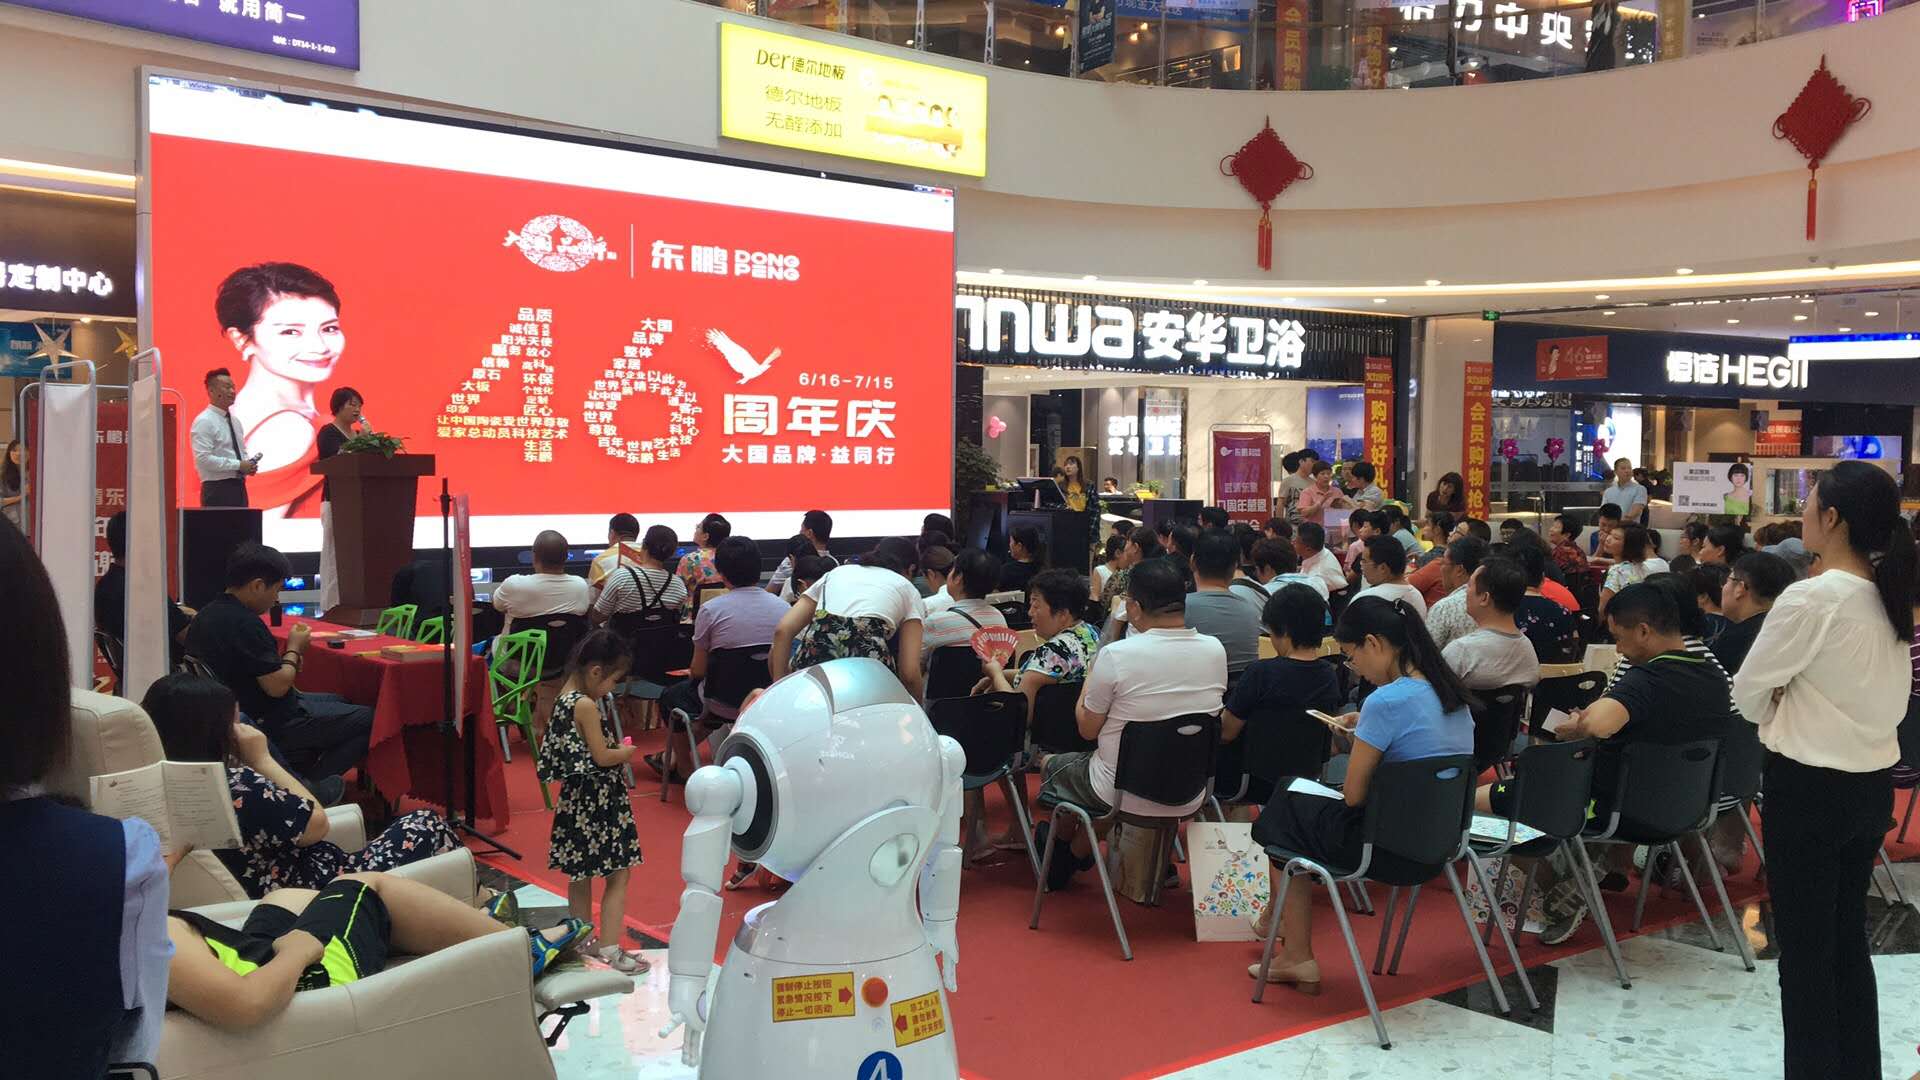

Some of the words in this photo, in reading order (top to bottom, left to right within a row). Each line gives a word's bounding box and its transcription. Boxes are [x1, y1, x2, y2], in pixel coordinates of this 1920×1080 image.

[1399, 0, 1594, 52] 力中央
[756, 49, 791, 69] Der
[792, 56, 846, 81] 德尔地板
[765, 84, 843, 112] 德尔地板
[765, 112, 843, 138] 无醛添加
[651, 240, 727, 276] 东鹏
[734, 249, 800, 269] DONG
[734, 265, 800, 283] PENG
[1143, 310, 1305, 369] 安华卫浴
[1667, 350, 1720, 384] 恒洁
[723, 394, 897, 438] 周年庆
[1370, 400, 1389, 498] 购物好礼
